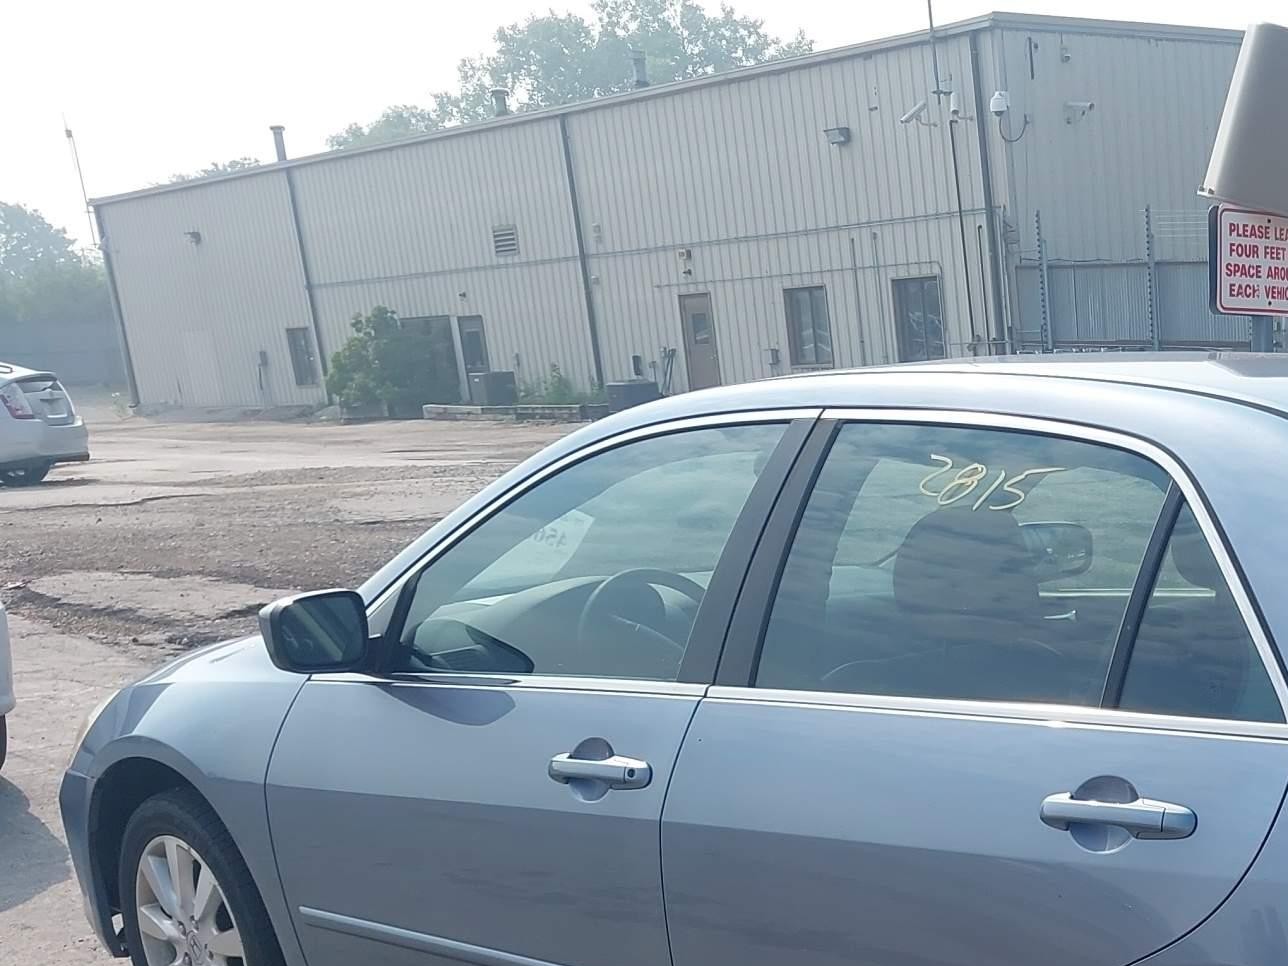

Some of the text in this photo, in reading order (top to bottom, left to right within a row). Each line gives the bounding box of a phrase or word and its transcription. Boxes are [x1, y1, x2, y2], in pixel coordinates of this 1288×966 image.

[1229, 223, 1270, 240] PLEASE
[1229, 243, 1259, 259] FOUR
[1264, 246, 1286, 261] FEET
[1225, 262, 1262, 278] SPACE
[1229, 283, 1260, 299] EACH
[920, 453, 1068, 512] 2815
